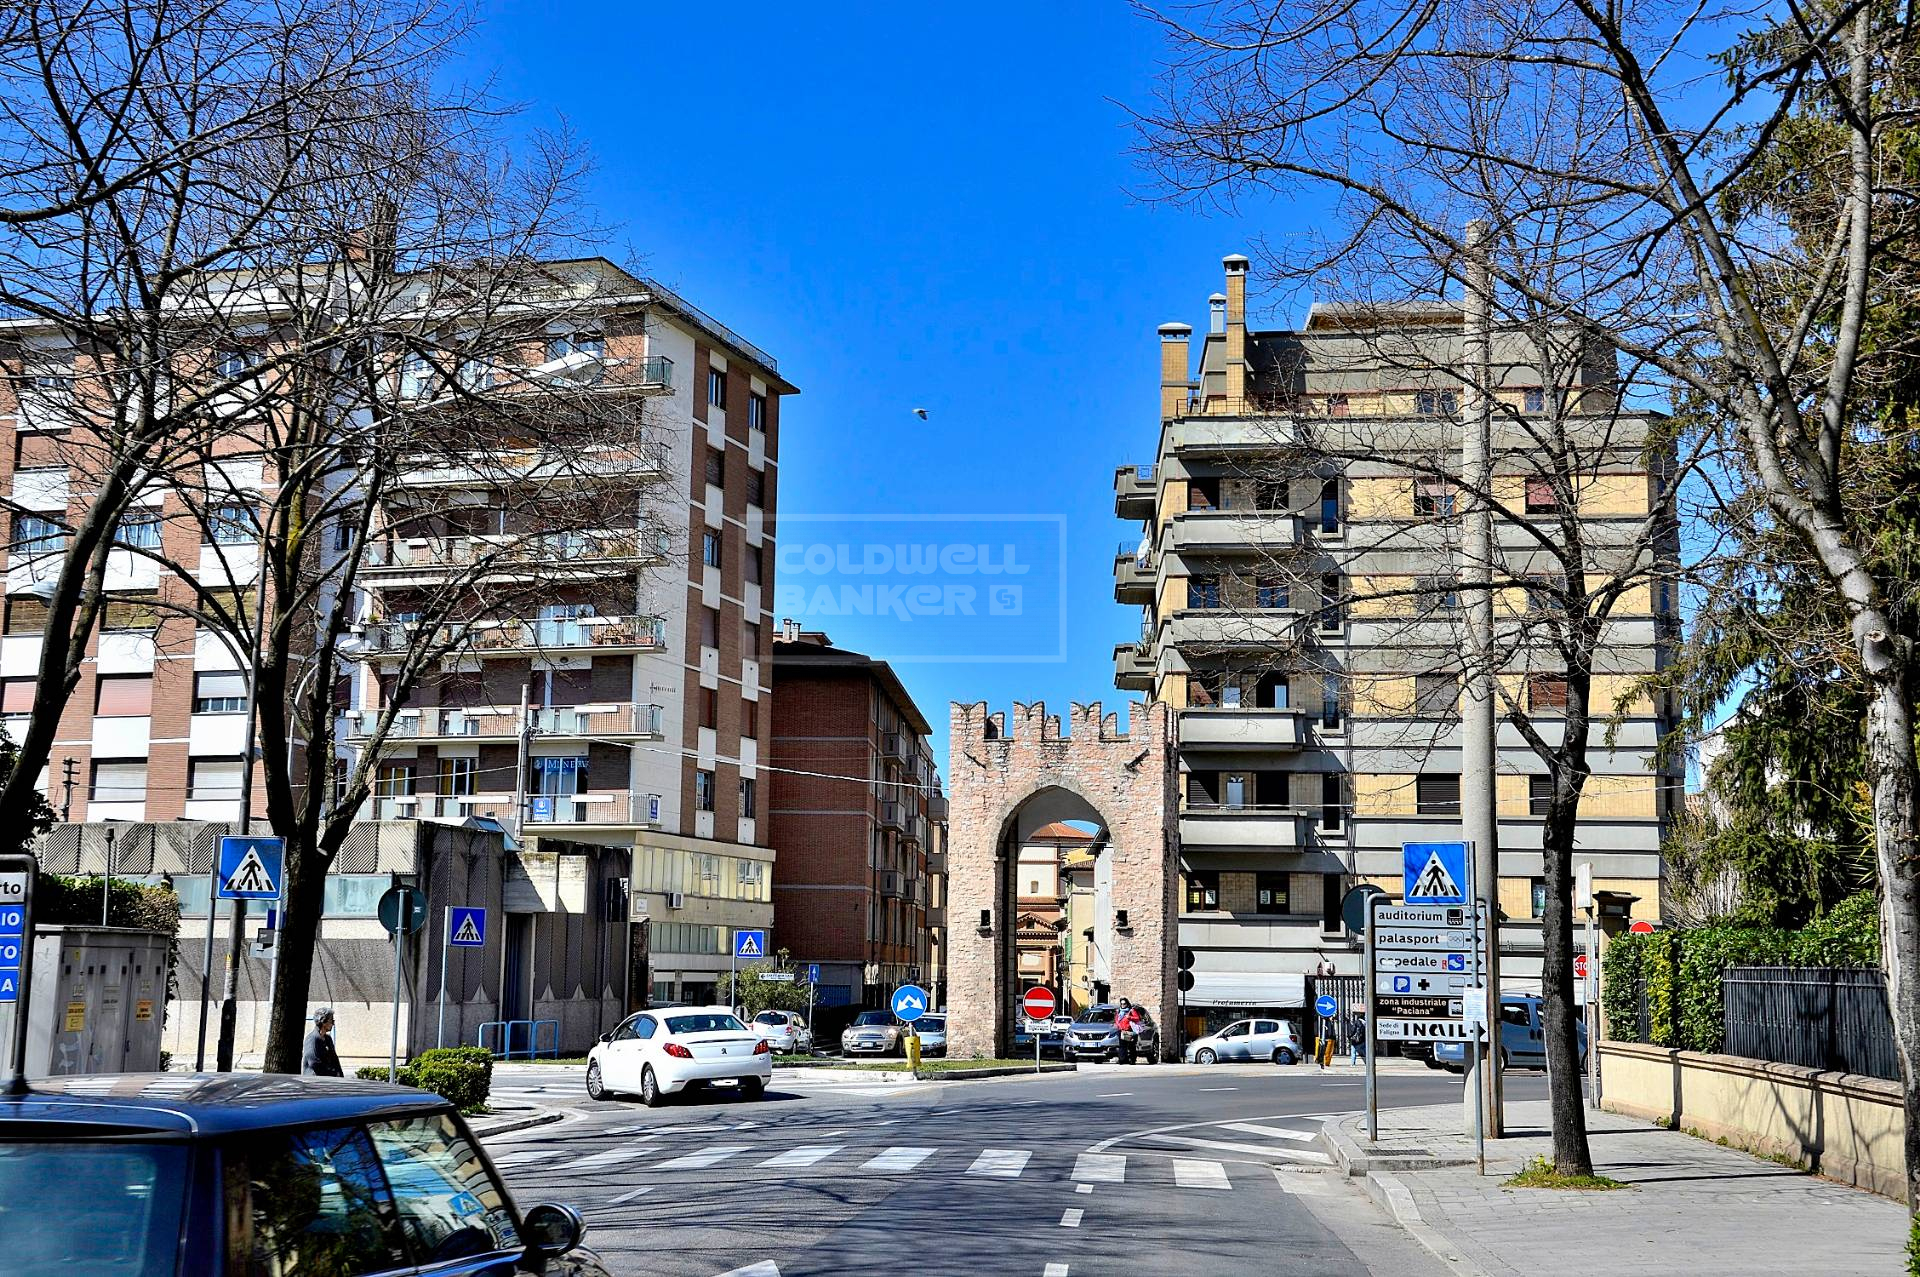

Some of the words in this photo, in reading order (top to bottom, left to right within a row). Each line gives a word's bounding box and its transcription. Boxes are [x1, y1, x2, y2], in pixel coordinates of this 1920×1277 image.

[1378, 910, 1443, 921] auditorium
[1379, 933, 1440, 945] palasport
[1379, 956, 1438, 968] opedale
[1575, 961, 1587, 971] STO
[1401, 998, 1447, 1006] industriale
[1403, 1023, 1467, 1038] INAIL
